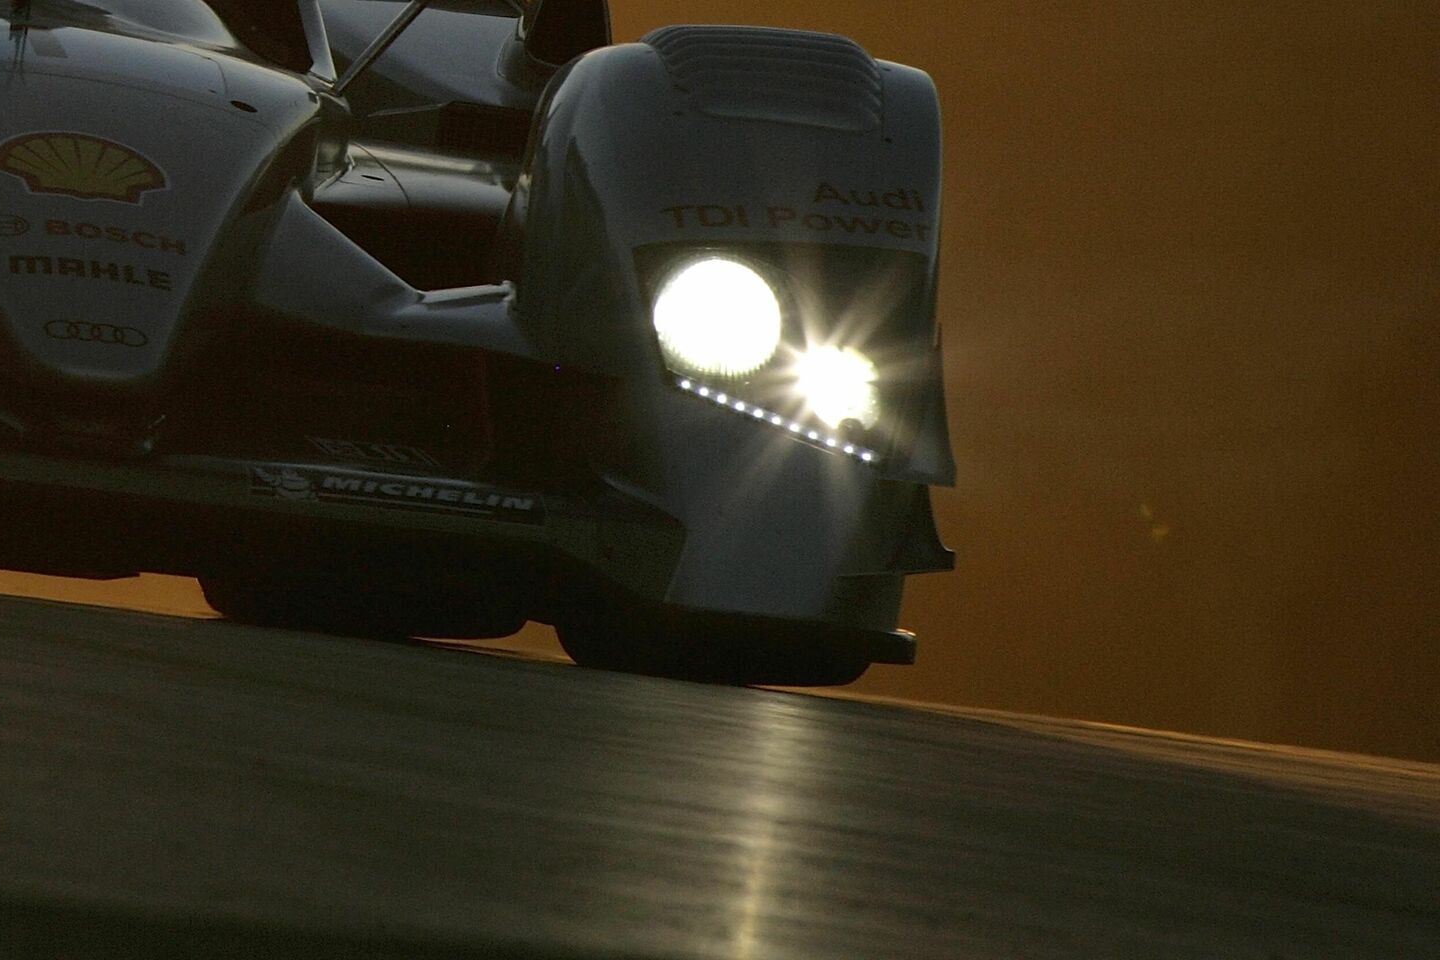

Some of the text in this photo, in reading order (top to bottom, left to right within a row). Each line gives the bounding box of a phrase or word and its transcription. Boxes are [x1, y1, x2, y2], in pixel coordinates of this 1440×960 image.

[814, 182, 926, 212] Audi
[45, 219, 187, 255] BOSCH
[659, 205, 930, 241] TDI Power
[10, 255, 173, 291] MAHLE
[321, 475, 534, 511] MICHELIN
